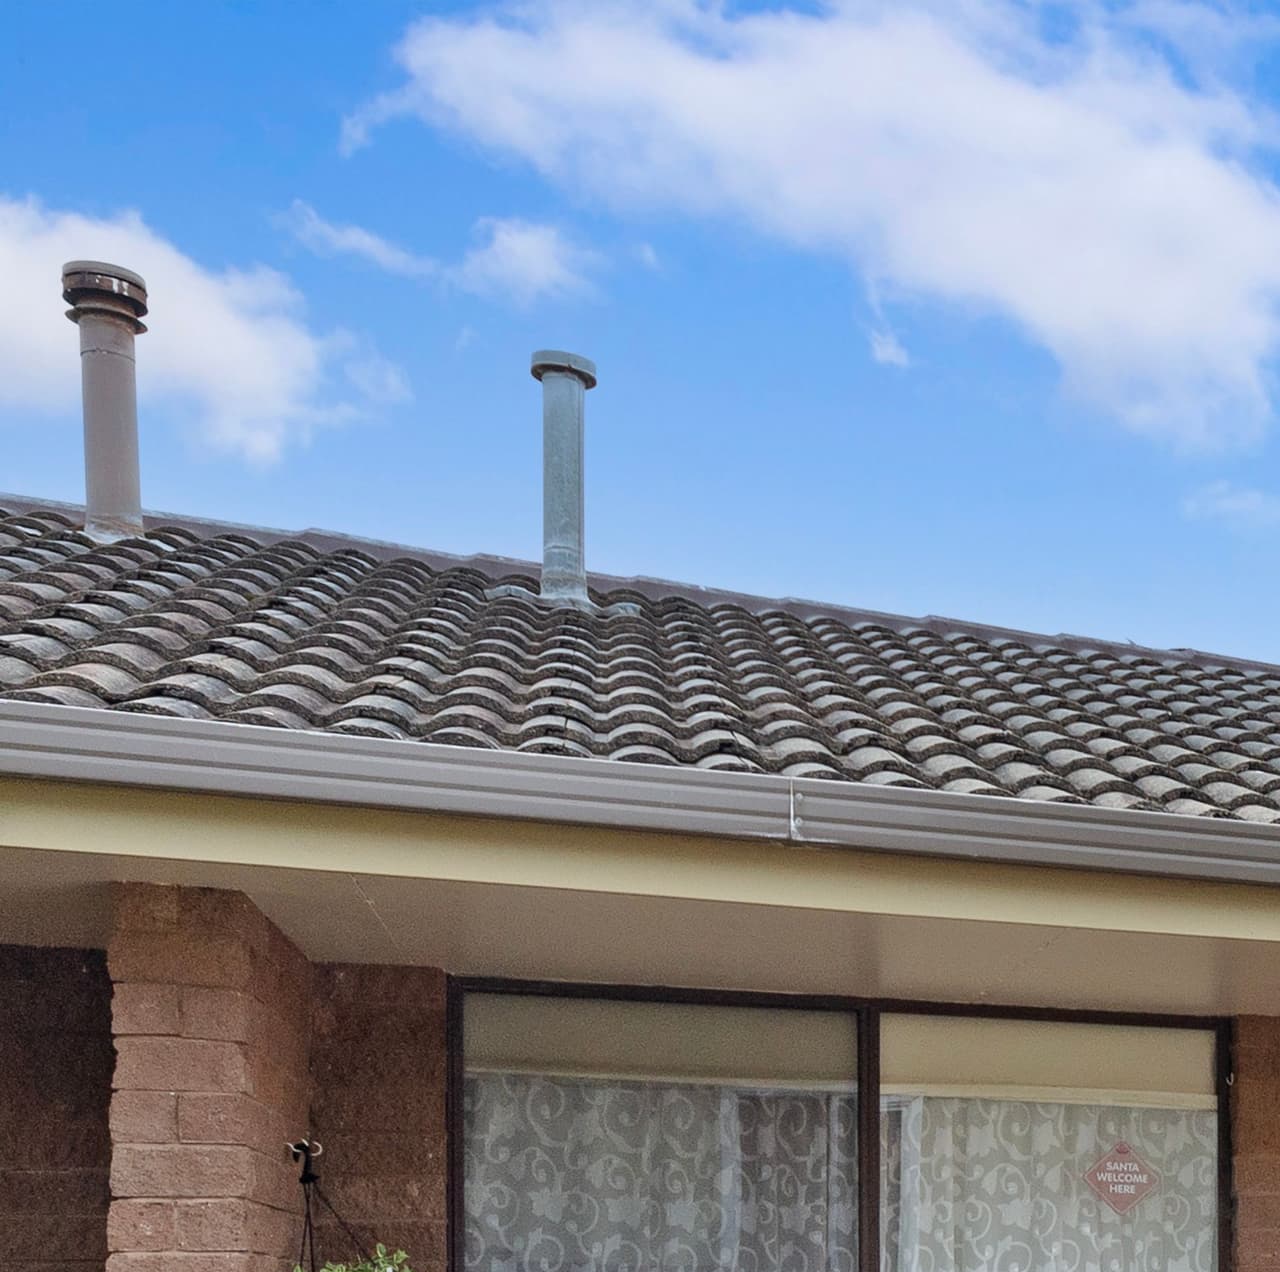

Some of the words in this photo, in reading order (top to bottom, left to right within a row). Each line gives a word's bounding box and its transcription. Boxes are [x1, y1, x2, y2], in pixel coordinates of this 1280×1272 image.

[1106, 1161, 1139, 1172] SANTA
[1096, 1171, 1149, 1184] WELCOME
[1109, 1183, 1136, 1194] HERE
